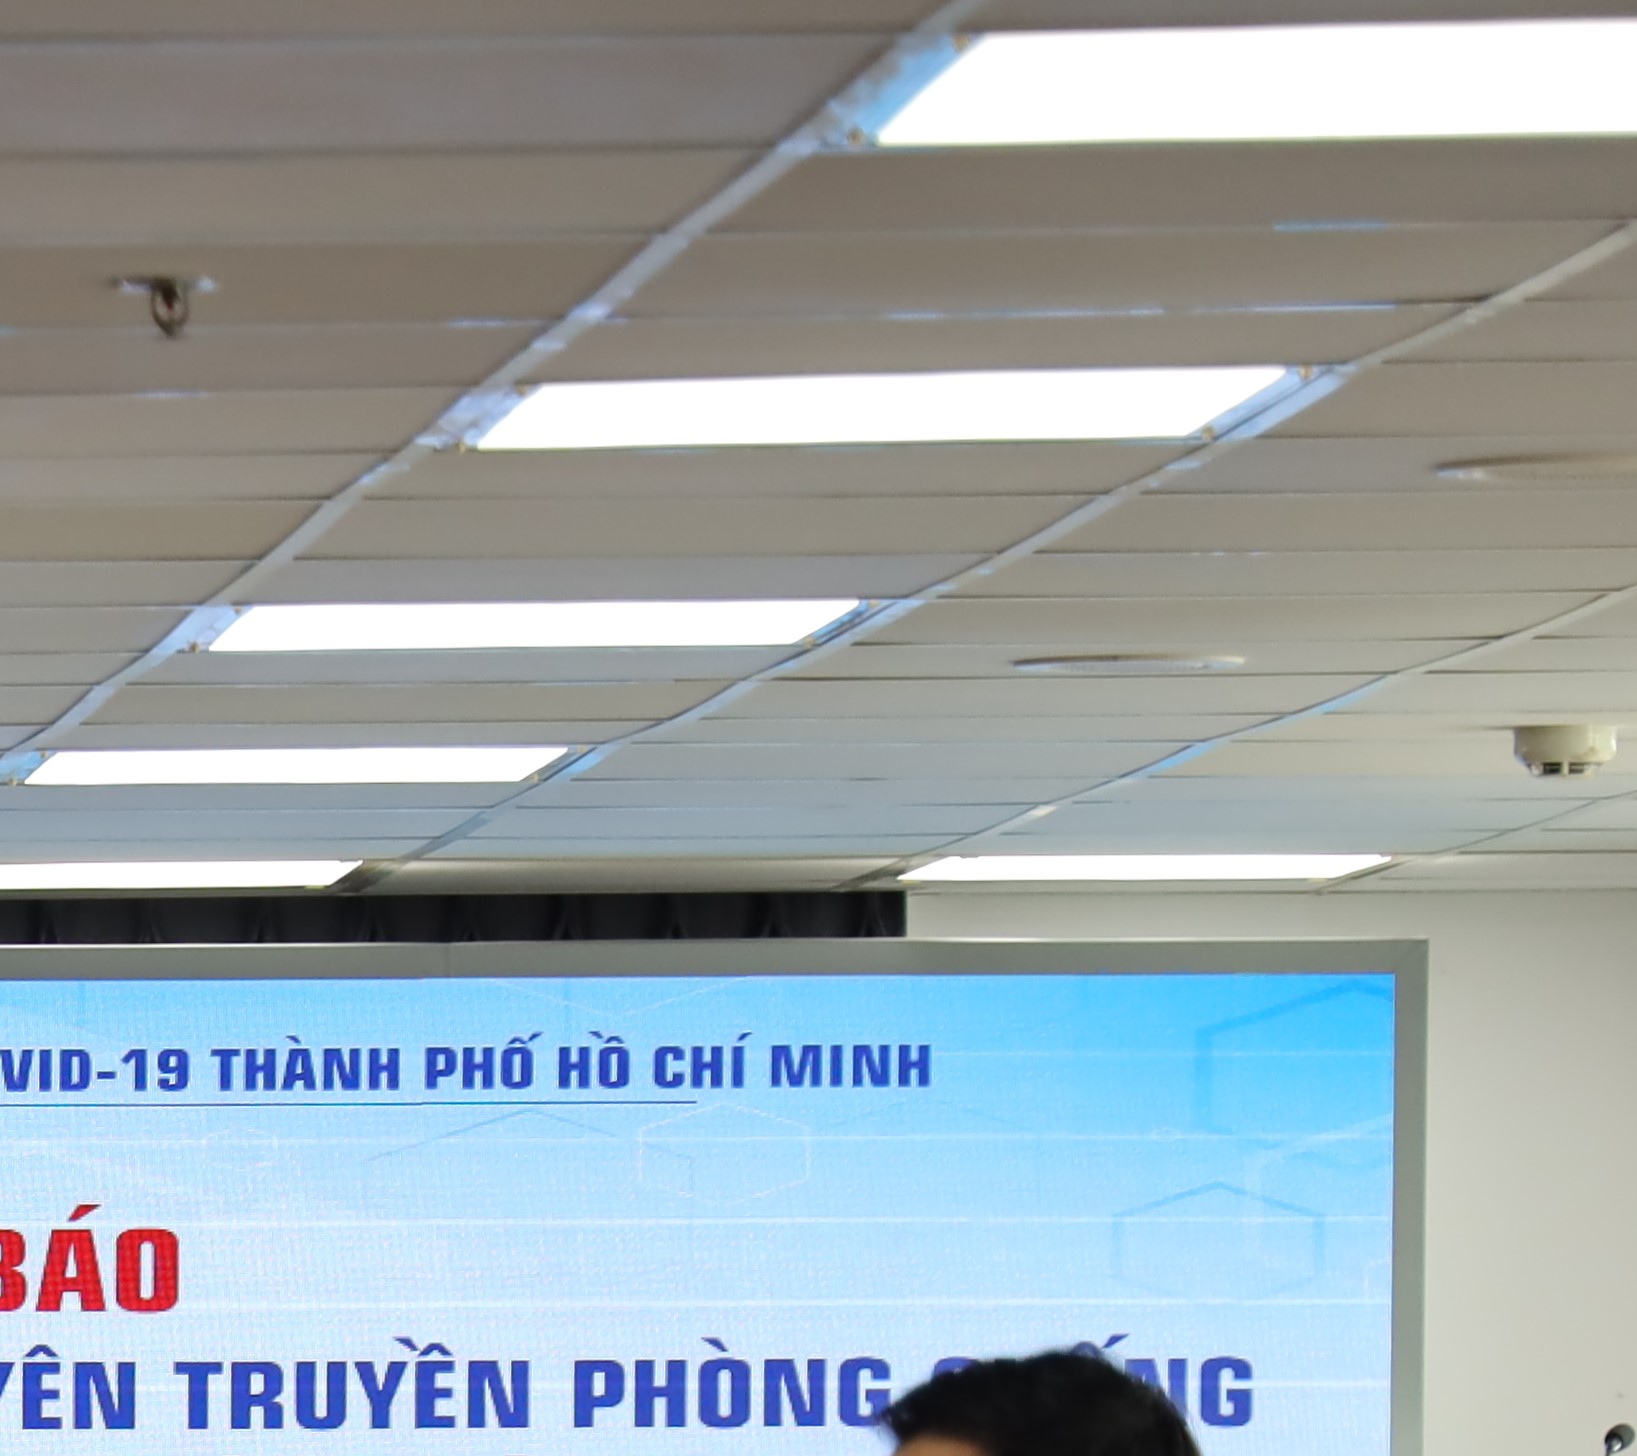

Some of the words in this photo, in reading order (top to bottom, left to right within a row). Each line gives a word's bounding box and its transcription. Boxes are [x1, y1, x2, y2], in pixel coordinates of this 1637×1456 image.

[209, 1035, 401, 1092] THÀNH
[423, 1032, 543, 1091] PHỐ
[557, 1030, 631, 1090] HỒ
[653, 1032, 752, 1090] CHÍ
[769, 1043, 932, 1088] MINH
[173, 1336, 530, 1430] TRUYỀN
[572, 1337, 892, 1428] PHÒNG
